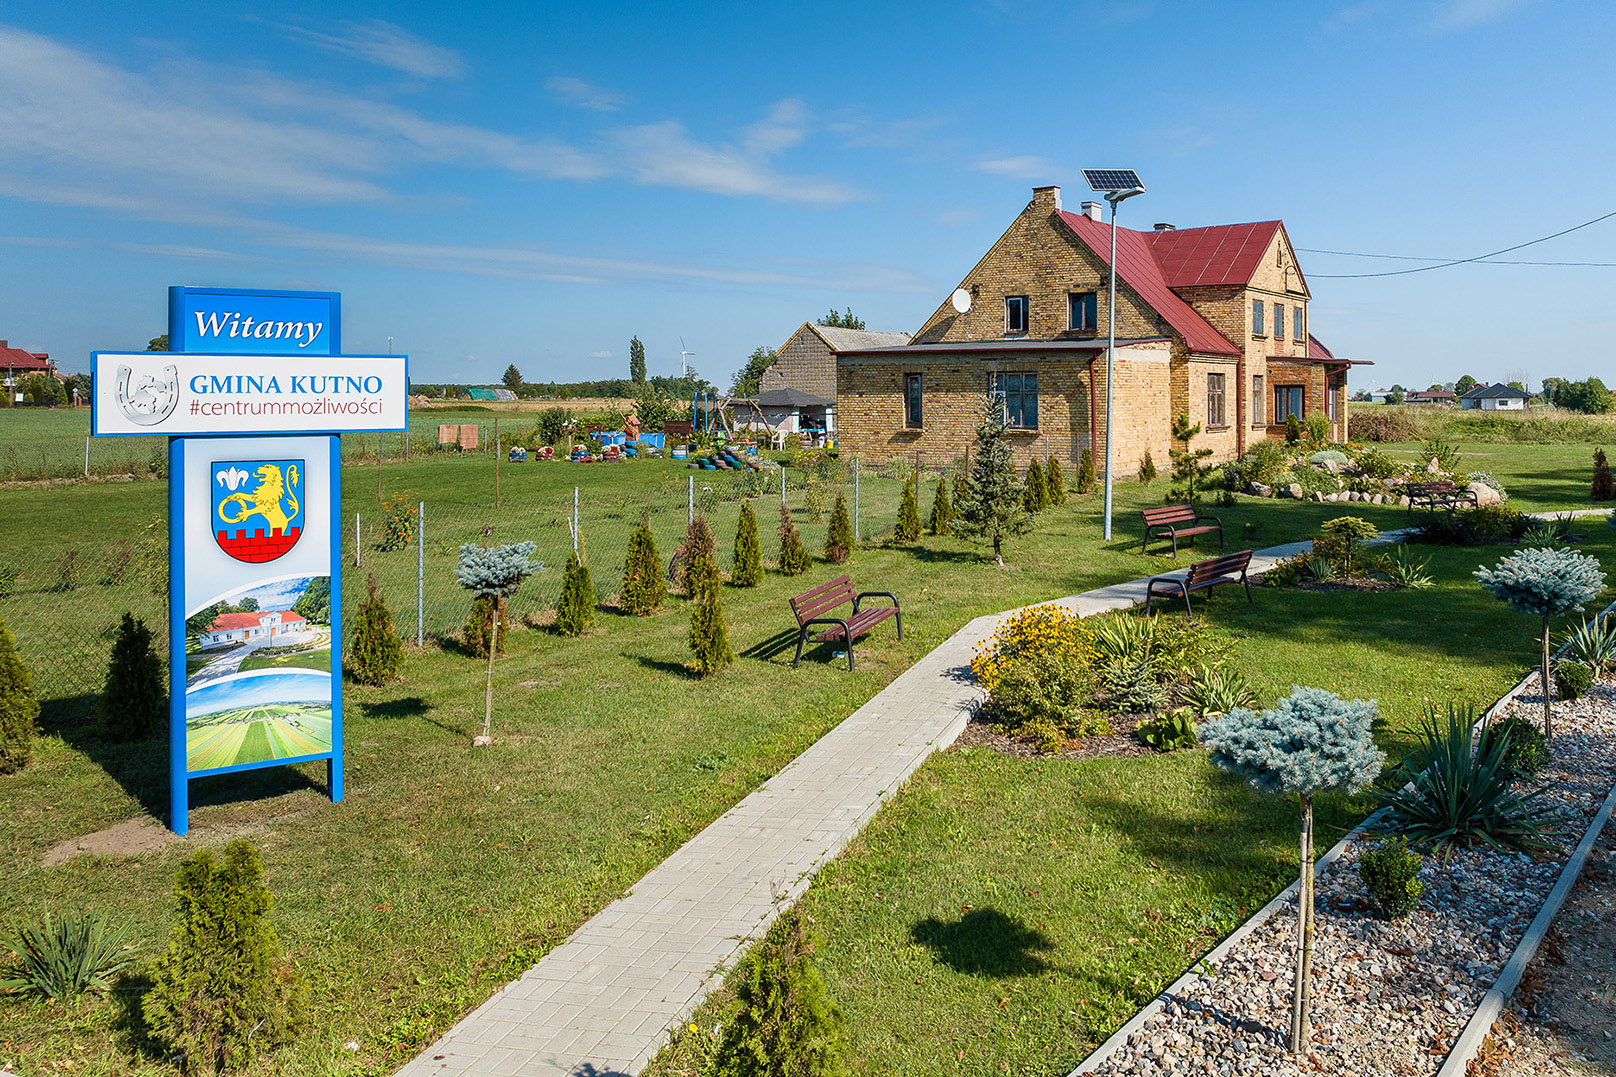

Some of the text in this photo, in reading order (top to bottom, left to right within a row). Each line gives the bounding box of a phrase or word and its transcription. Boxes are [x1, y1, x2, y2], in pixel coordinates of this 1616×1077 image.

[194, 311, 323, 347] Witamy
[189, 375, 383, 394] GMINA KUTNO
[189, 397, 383, 416] #centrummożliwości
